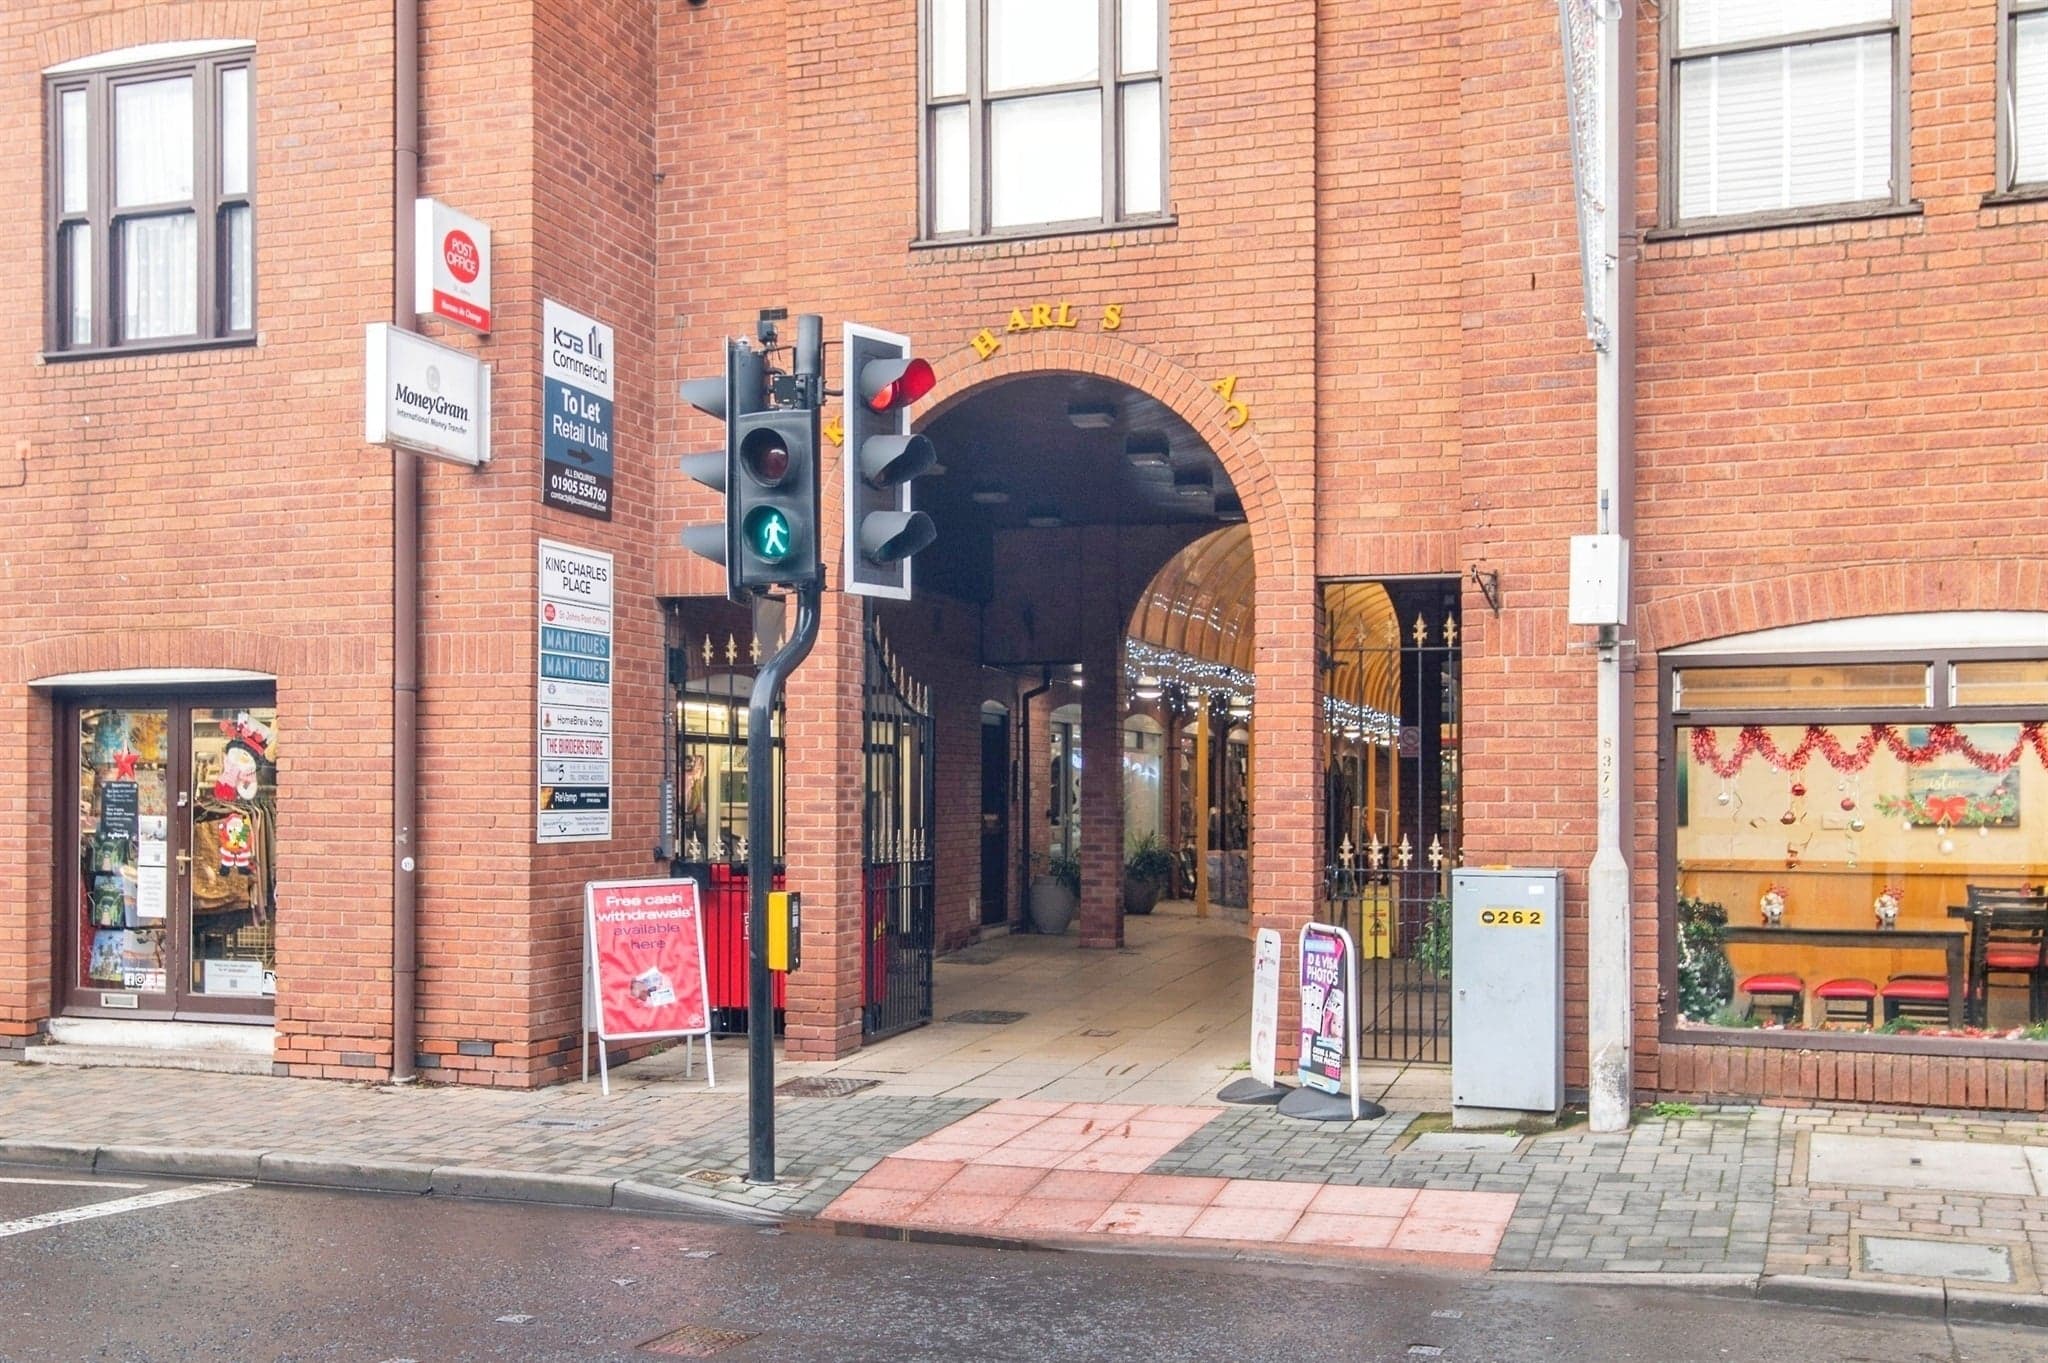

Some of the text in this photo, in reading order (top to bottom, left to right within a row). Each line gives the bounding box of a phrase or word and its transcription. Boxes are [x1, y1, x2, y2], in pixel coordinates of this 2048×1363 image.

[452, 238, 473, 257] POST
[446, 251, 477, 275] OFFICE
[553, 327, 584, 354] KJB
[553, 349, 607, 384] Commercial
[395, 384, 469, 421] MoneyGram
[561, 388, 601, 423] To Let
[397, 408, 467, 434] International Money Transfer
[553, 414, 608, 452] Retail Unit
[551, 475, 607, 502] 01905 554760
[545, 556, 608, 582] KING CHARLES
[563, 576, 591, 594] PLACE
[546, 630, 606, 655] MANTIQUES
[546, 656, 606, 680] MANTIQUES
[557, 714, 603, 727] HomeBrew Shop
[546, 738, 603, 755] THE BIRDERS STORE
[606, 892, 683, 907] Free cash
[613, 922, 681, 936] available
[631, 938, 667, 950] here
[1306, 965, 1338, 985] PHOTOS
